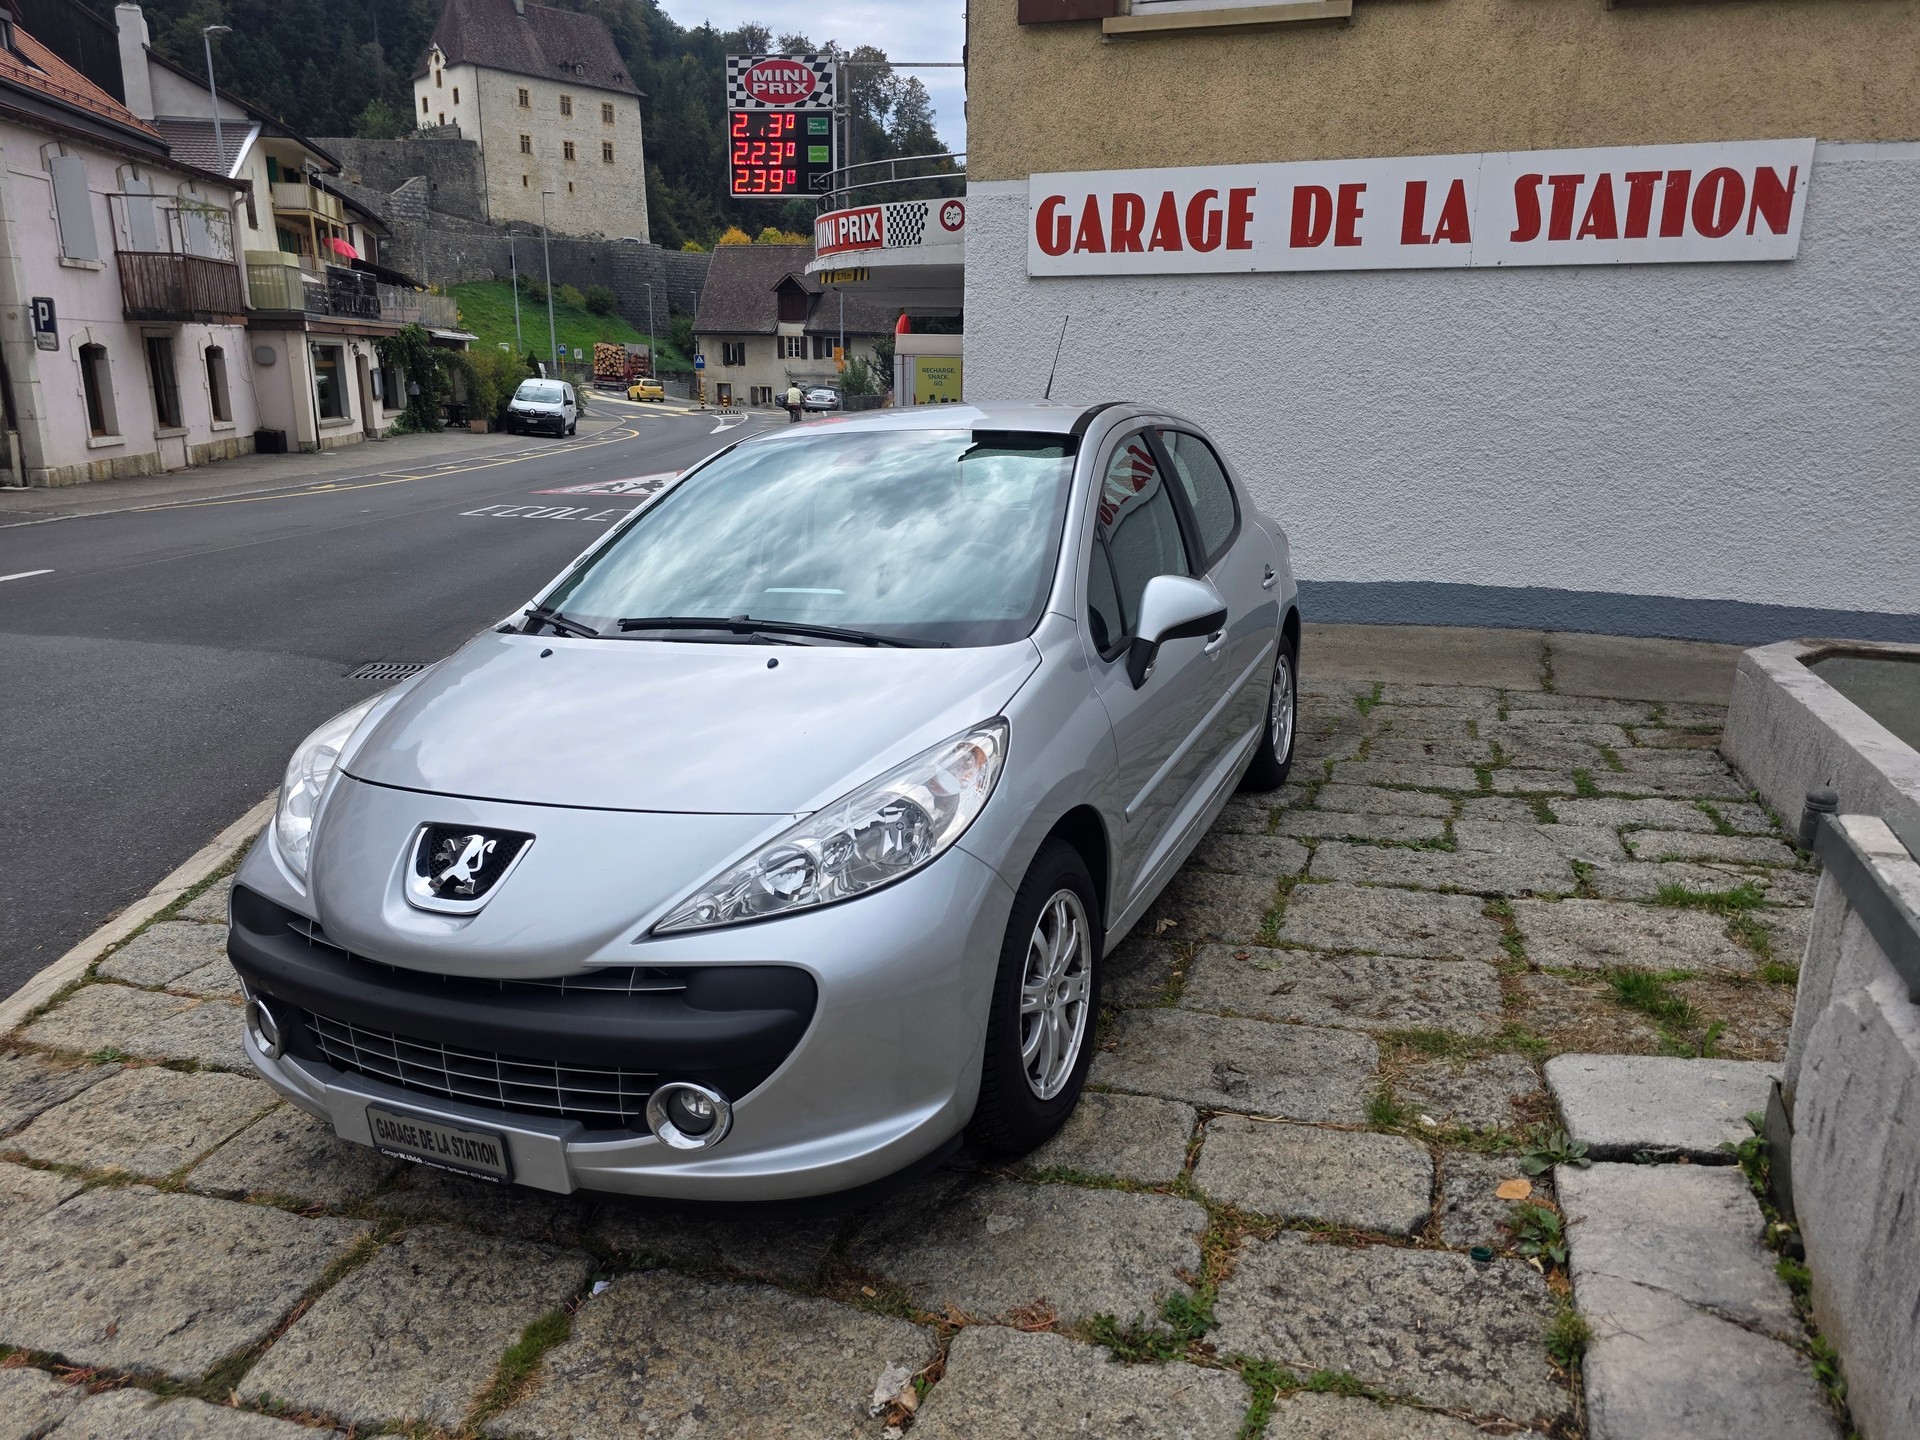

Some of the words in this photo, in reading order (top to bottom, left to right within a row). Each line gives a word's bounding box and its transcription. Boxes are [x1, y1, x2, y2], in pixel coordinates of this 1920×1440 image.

[752, 69, 808, 82] MINI
[752, 82, 809, 95] PRIX
[1035, 187, 1257, 257] GARAGE
[1289, 183, 1368, 249] DE
[1400, 179, 1472, 245] LA
[1509, 165, 1798, 243] STATION
[817, 219, 836, 249] MINI
[838, 212, 881, 245] PRIX
[38, 302, 49, 330] P
[457, 504, 633, 522] ECOLE
[376, 1118, 419, 1147] GARAGE
[418, 1128, 436, 1152] DE
[435, 1132, 452, 1156] LA
[450, 1135, 500, 1167] STATION
